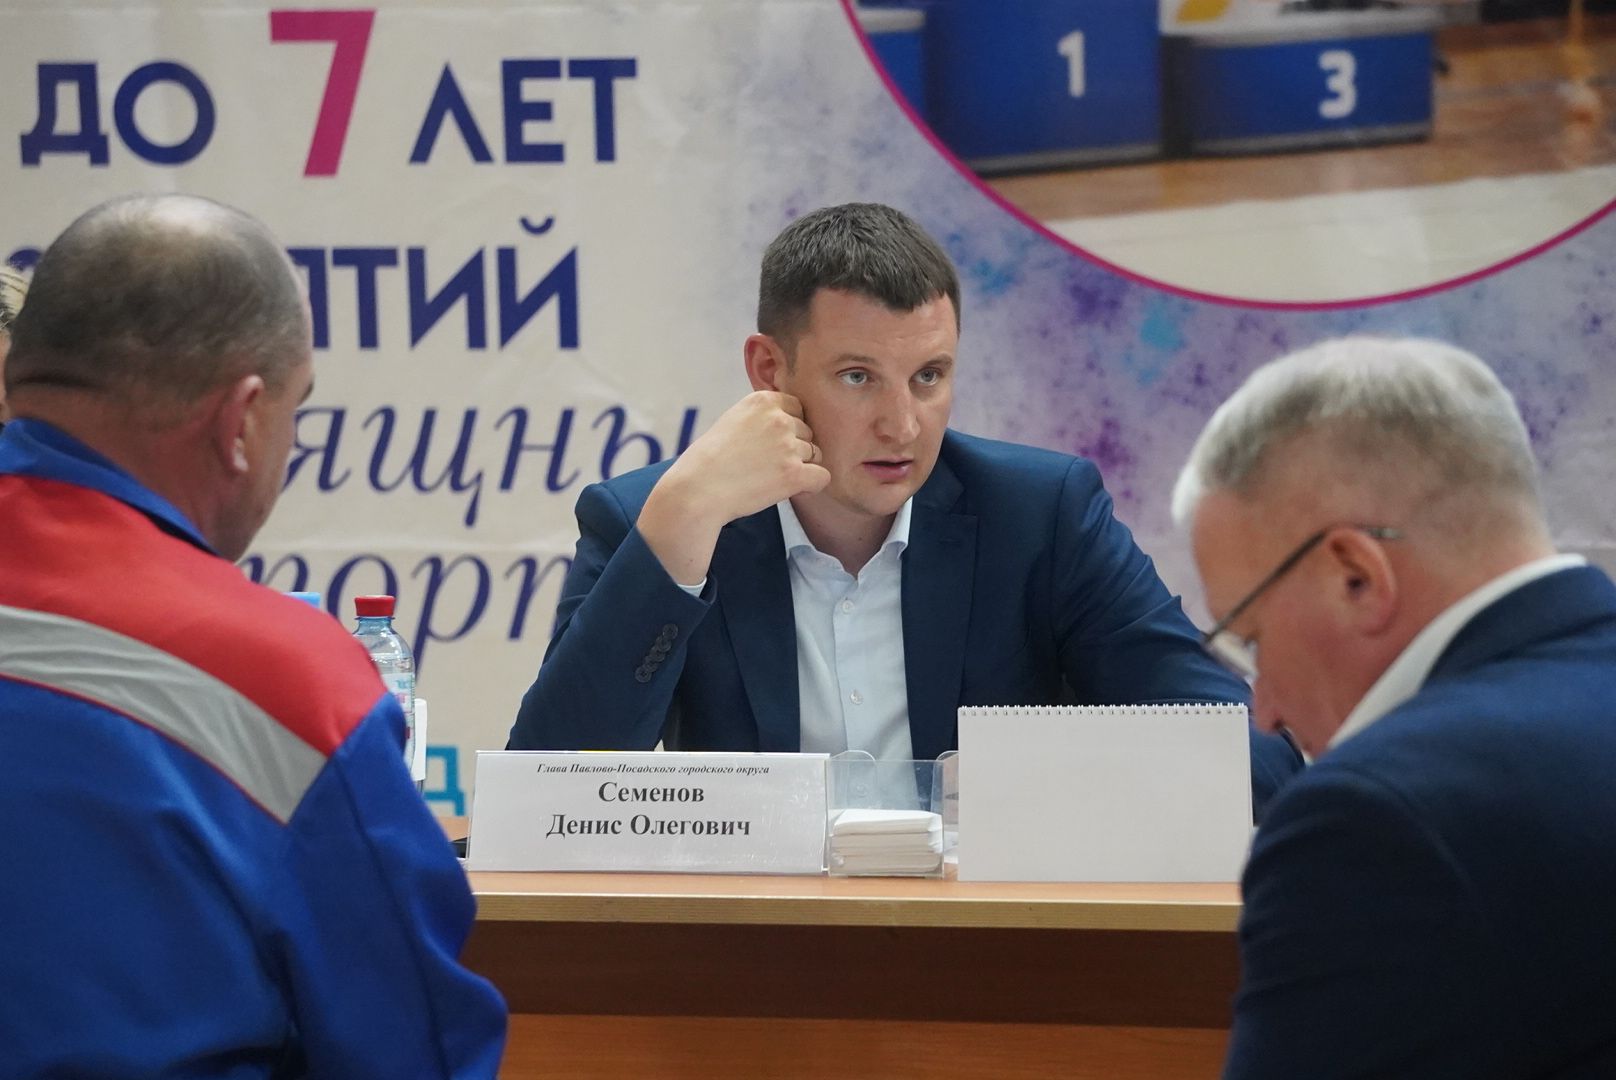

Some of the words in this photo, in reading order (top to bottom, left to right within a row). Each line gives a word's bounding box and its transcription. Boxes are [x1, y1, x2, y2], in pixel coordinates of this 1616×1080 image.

[1057, 29, 1086, 98] 1
[1318, 50, 1357, 119] 3
[20, 61, 216, 166] ДО
[269, 10, 376, 177] 7
[408, 57, 638, 164] ЛЕТ
[537, 763, 568, 774] Глава
[570, 763, 676, 774] Павлово-Посадского
[678, 764, 734, 776] городского
[736, 765, 770, 777] округа
[598, 781, 705, 803] Семенов
[546, 814, 622, 839] Денис
[630, 814, 751, 836] Олегович
